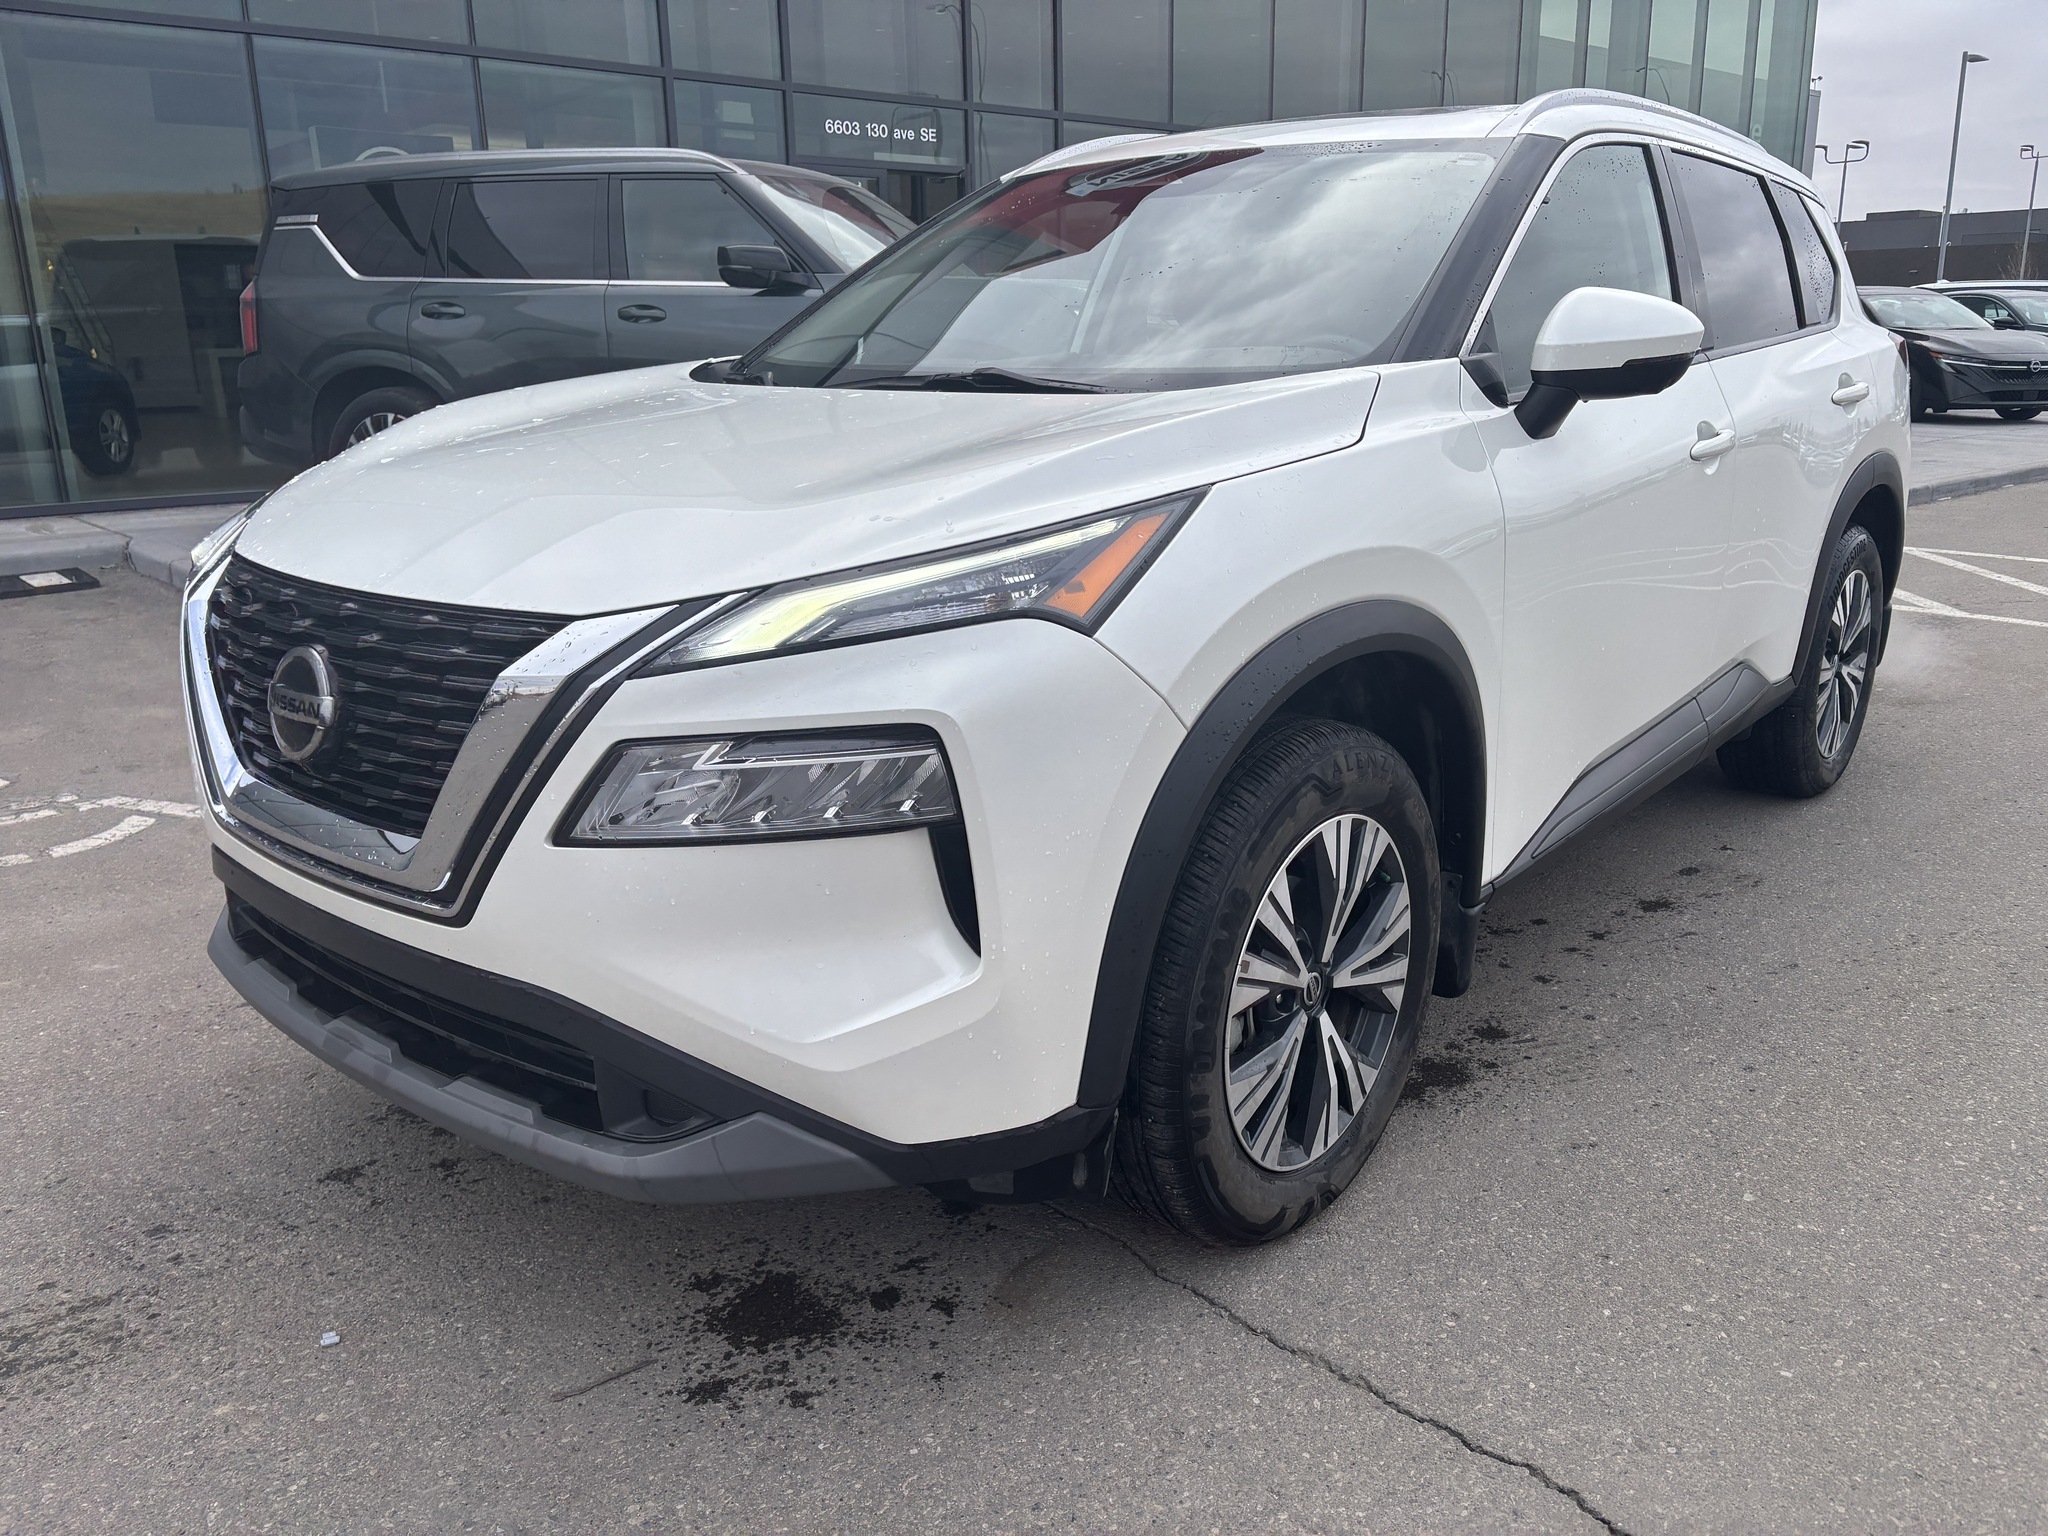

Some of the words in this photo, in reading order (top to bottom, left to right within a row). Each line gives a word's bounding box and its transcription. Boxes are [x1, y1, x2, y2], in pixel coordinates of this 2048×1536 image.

[825, 119, 861, 136] 6603
[865, 123, 888, 138] 130
[893, 128, 915, 140] ave
[920, 127, 937, 142] SE
[270, 690, 320, 719] NISSAN
[1331, 751, 1400, 779] ALENZA
